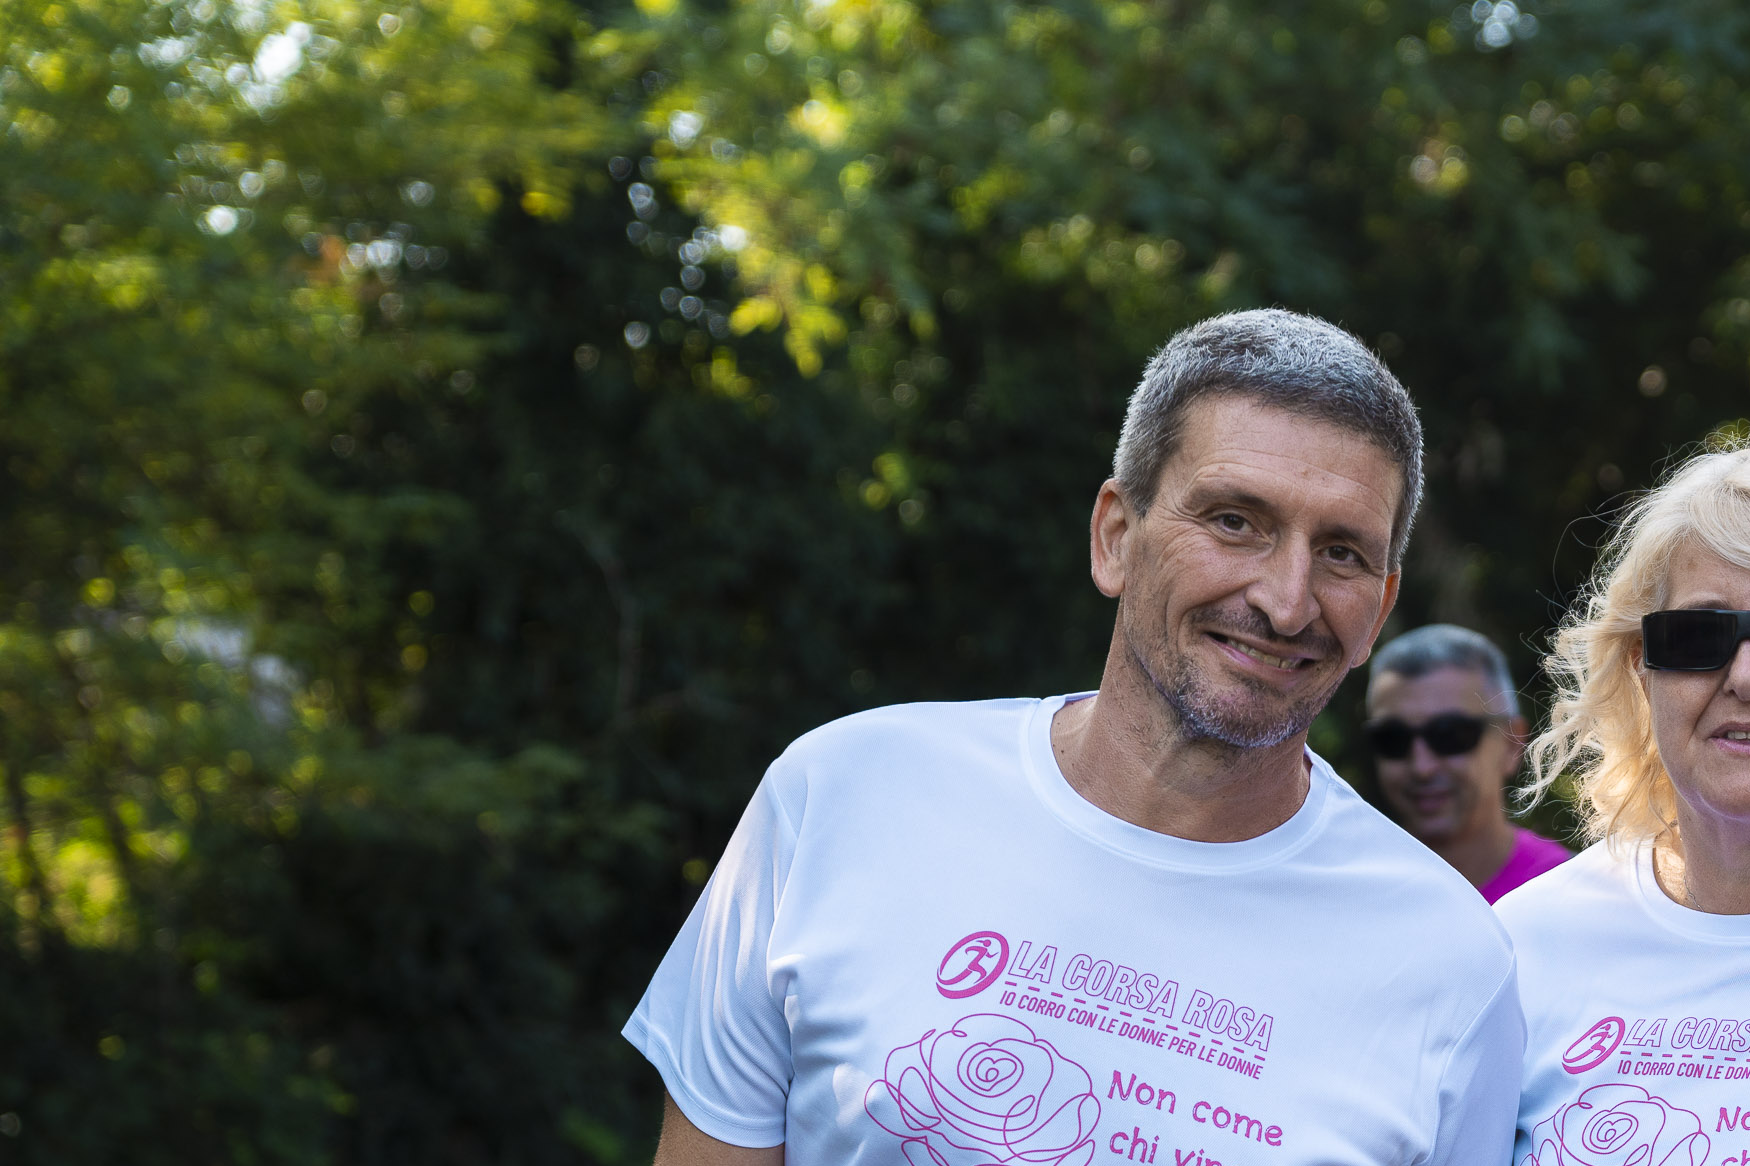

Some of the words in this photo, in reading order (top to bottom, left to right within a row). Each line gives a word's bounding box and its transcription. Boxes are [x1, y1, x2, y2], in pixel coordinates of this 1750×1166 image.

[1008, 941, 1058, 984] LA
[1062, 954, 1179, 1019] CORSA
[1182, 989, 1274, 1052] ROSA
[1000, 990, 1014, 1007] IO
[1018, 994, 1065, 1020] CORRO
[1068, 1007, 1098, 1028] CON
[1098, 1015, 1117, 1033] LE
[1118, 1021, 1167, 1049] DONNE
[1168, 1034, 1196, 1056] PER
[1198, 1043, 1216, 1061] LE
[1218, 1049, 1265, 1080] DONNE
[1623, 1018, 1667, 1047] LA
[1617, 1060, 1632, 1075] IO
[1633, 1061, 1675, 1076] CORRO
[1677, 1063, 1704, 1078] CON
[1706, 1065, 1724, 1079] LE
[1107, 1070, 1176, 1114] Non
[1193, 1099, 1284, 1147] come
[1110, 1127, 1158, 1165] chi
